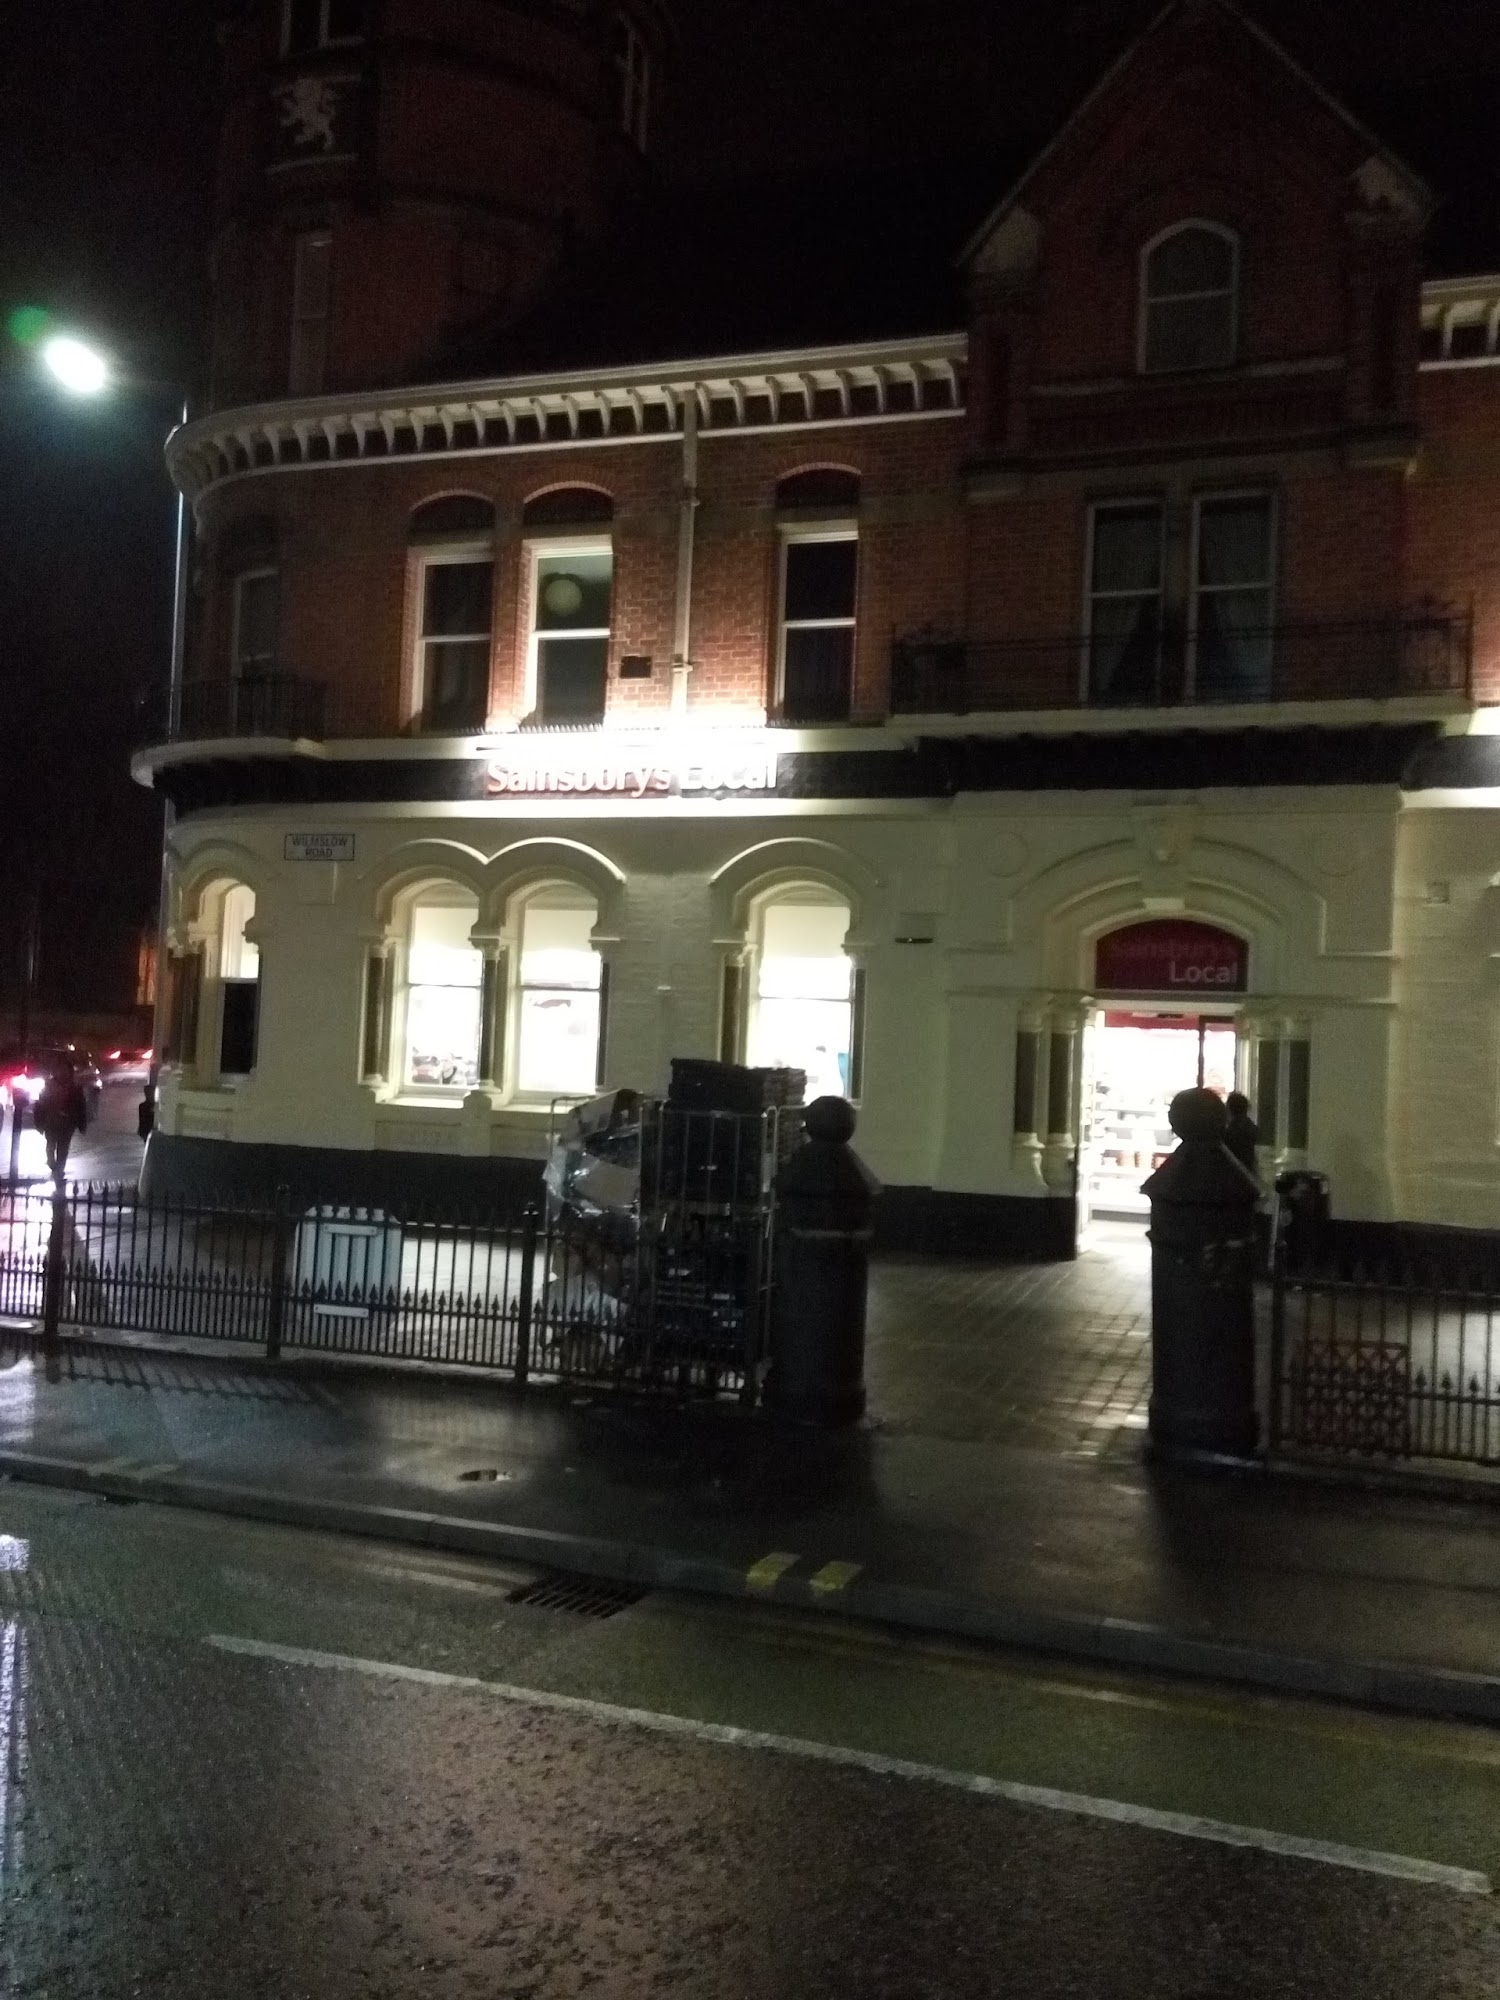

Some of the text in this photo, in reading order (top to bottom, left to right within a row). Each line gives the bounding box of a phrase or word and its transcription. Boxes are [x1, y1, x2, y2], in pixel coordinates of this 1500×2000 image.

[487, 759, 670, 798] Sainsburys
[305, 848, 333, 857] ROAD
[1170, 960, 1238, 983] Local
